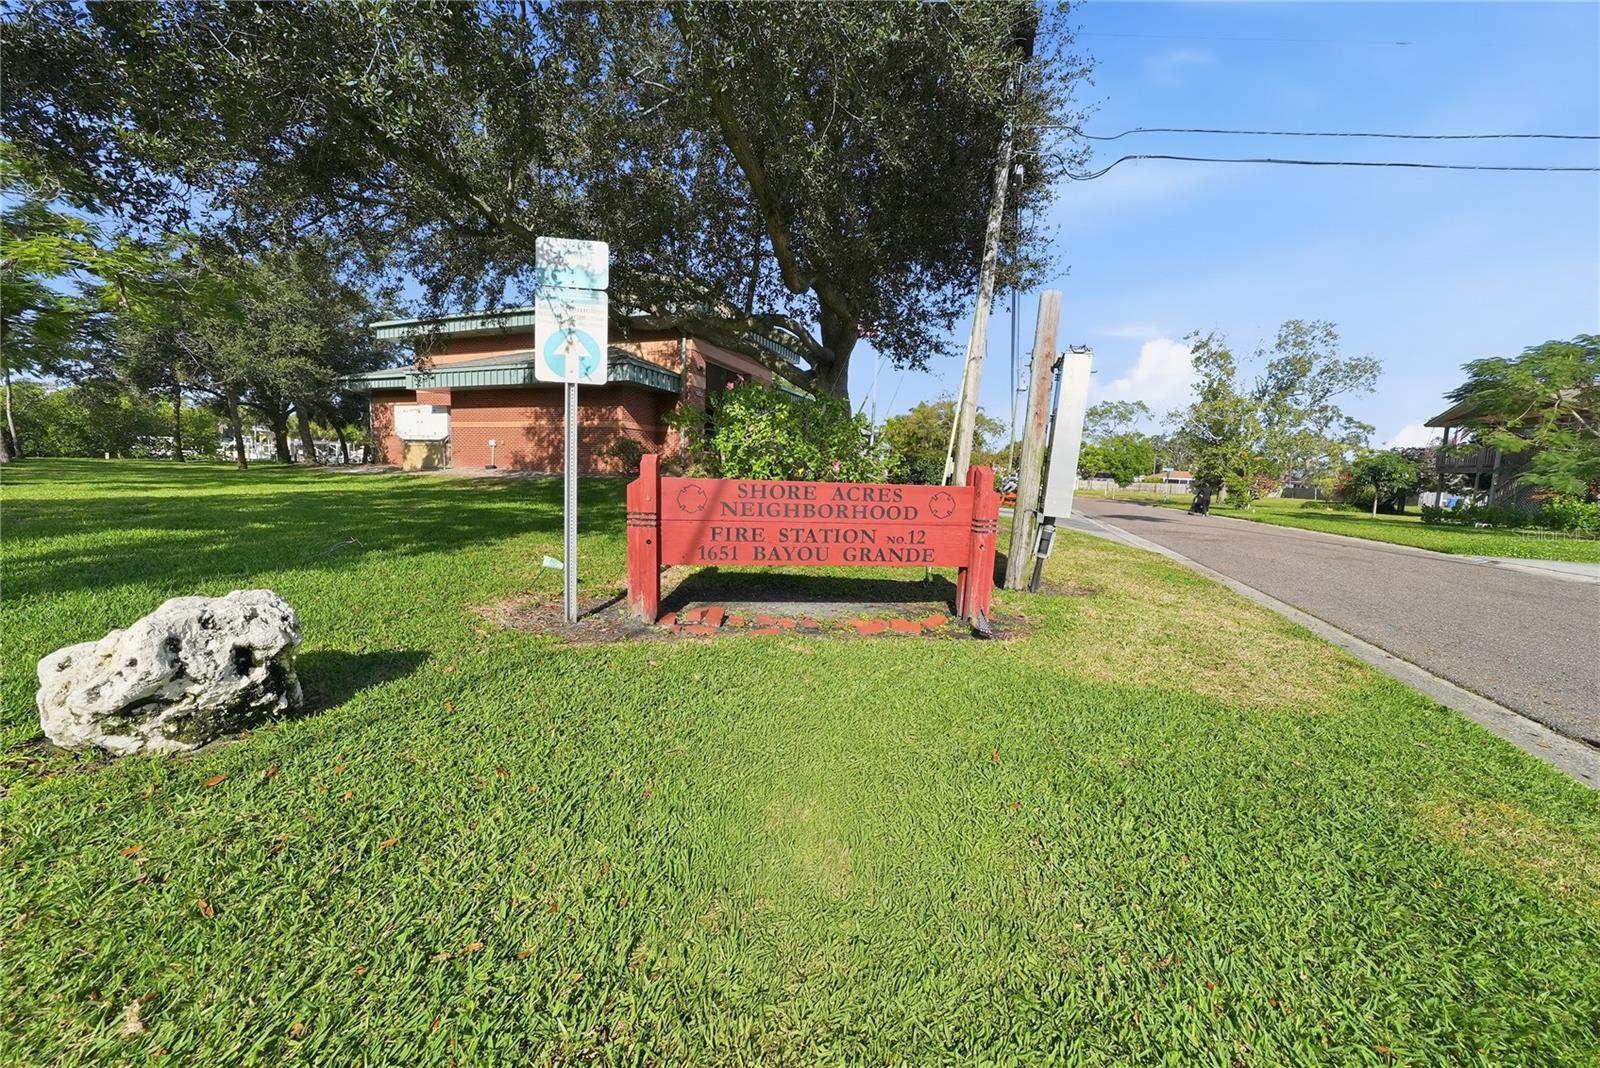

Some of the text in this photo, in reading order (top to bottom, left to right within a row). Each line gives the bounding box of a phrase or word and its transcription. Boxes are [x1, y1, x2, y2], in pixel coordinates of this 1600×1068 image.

[737, 484, 903, 502] SHORE ACRES
[720, 501, 918, 521] NEIGHBORHOOD
[710, 527, 765, 543] FIRE
[778, 528, 877, 544] STATION
[698, 545, 935, 563] 1651 BAYOU GRANDE
